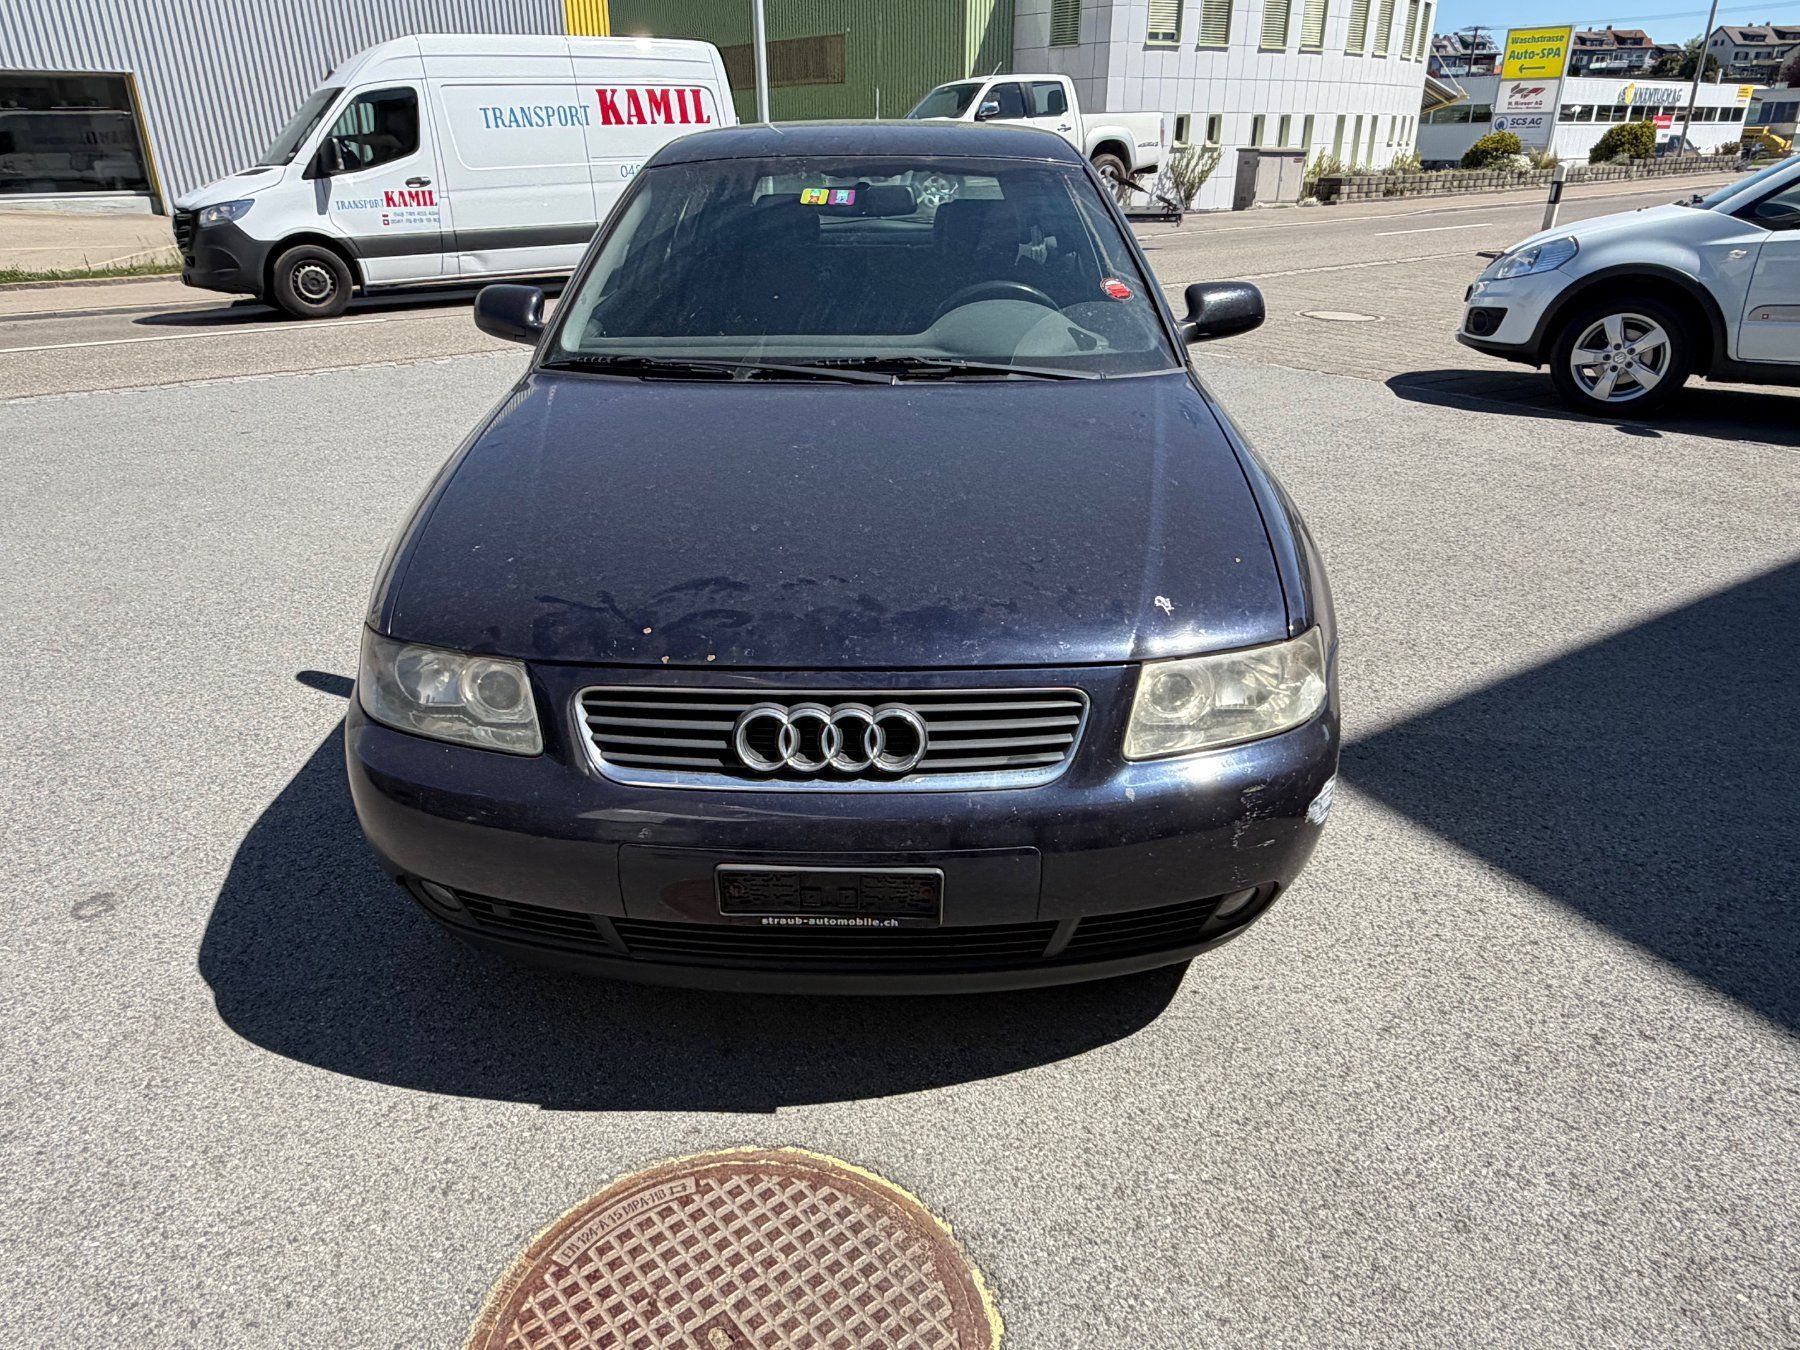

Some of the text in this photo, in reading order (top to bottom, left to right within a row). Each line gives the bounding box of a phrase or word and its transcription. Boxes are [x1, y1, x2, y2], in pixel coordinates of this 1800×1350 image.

[1511, 35, 1564, 45] Waschstrasse
[1508, 47, 1561, 60] Auto-SPA
[479, 88, 711, 128] TRANSPORT KAMIL
[1510, 117, 1542, 126] SCS AG
[335, 190, 438, 211] TRANSPORT KAMIL
[761, 917, 899, 927] straub-automobile.ch
[561, 1241, 580, 1260] EN
[608, 1210, 624, 1225] 15
